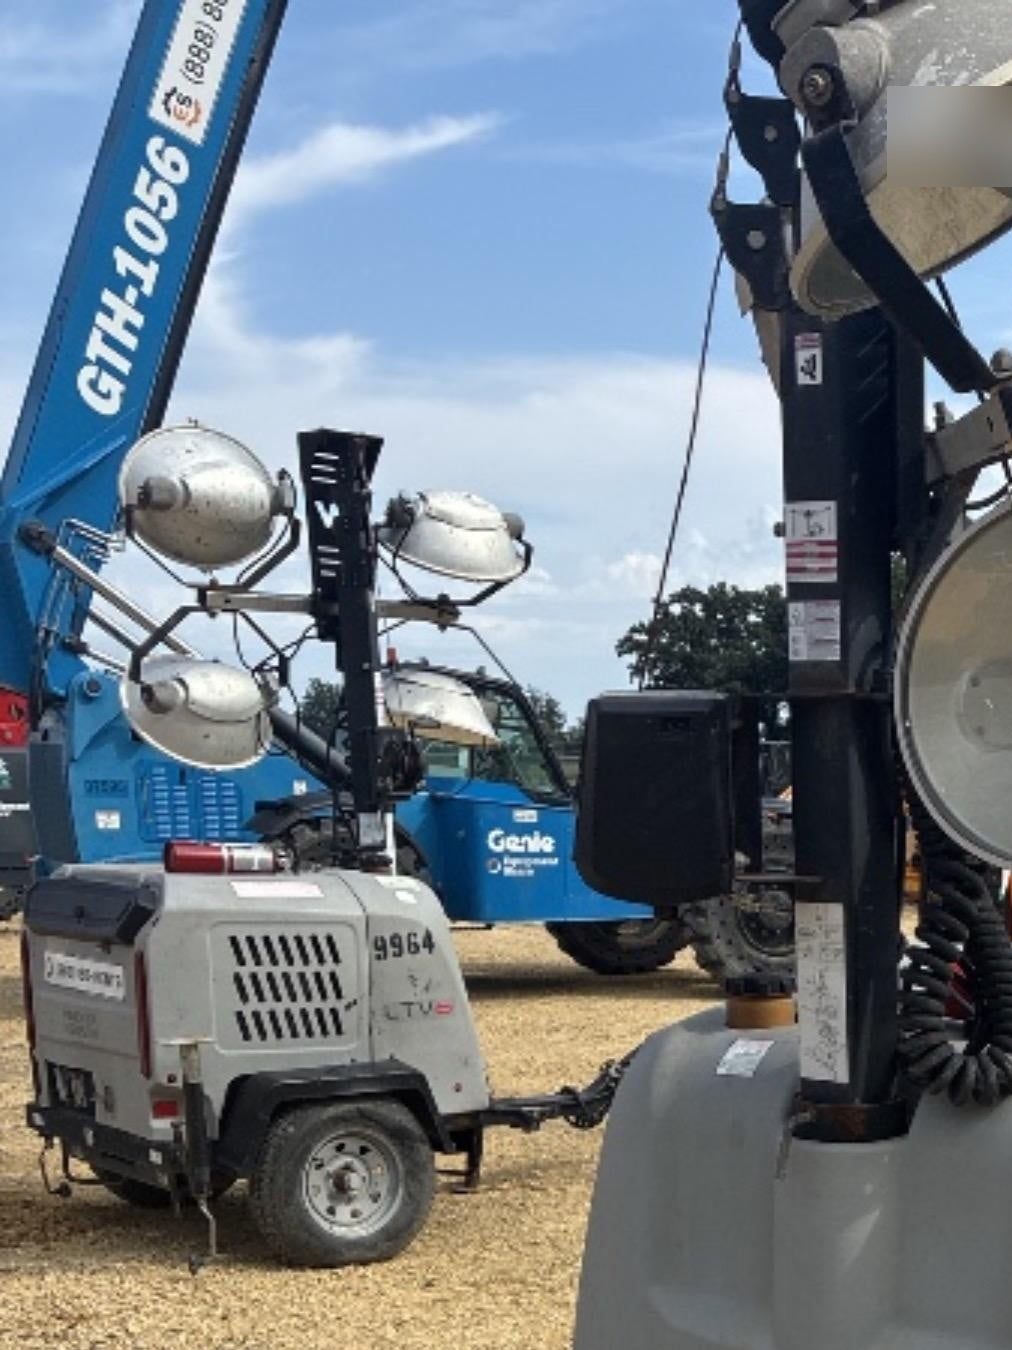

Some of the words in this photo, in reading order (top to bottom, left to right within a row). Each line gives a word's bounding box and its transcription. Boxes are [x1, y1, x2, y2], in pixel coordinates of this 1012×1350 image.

[179, 21, 218, 84] (888)
[76, 135, 191, 416] GTH-1056
[487, 827, 556, 854] Genie
[374, 928, 436, 960] 9964
